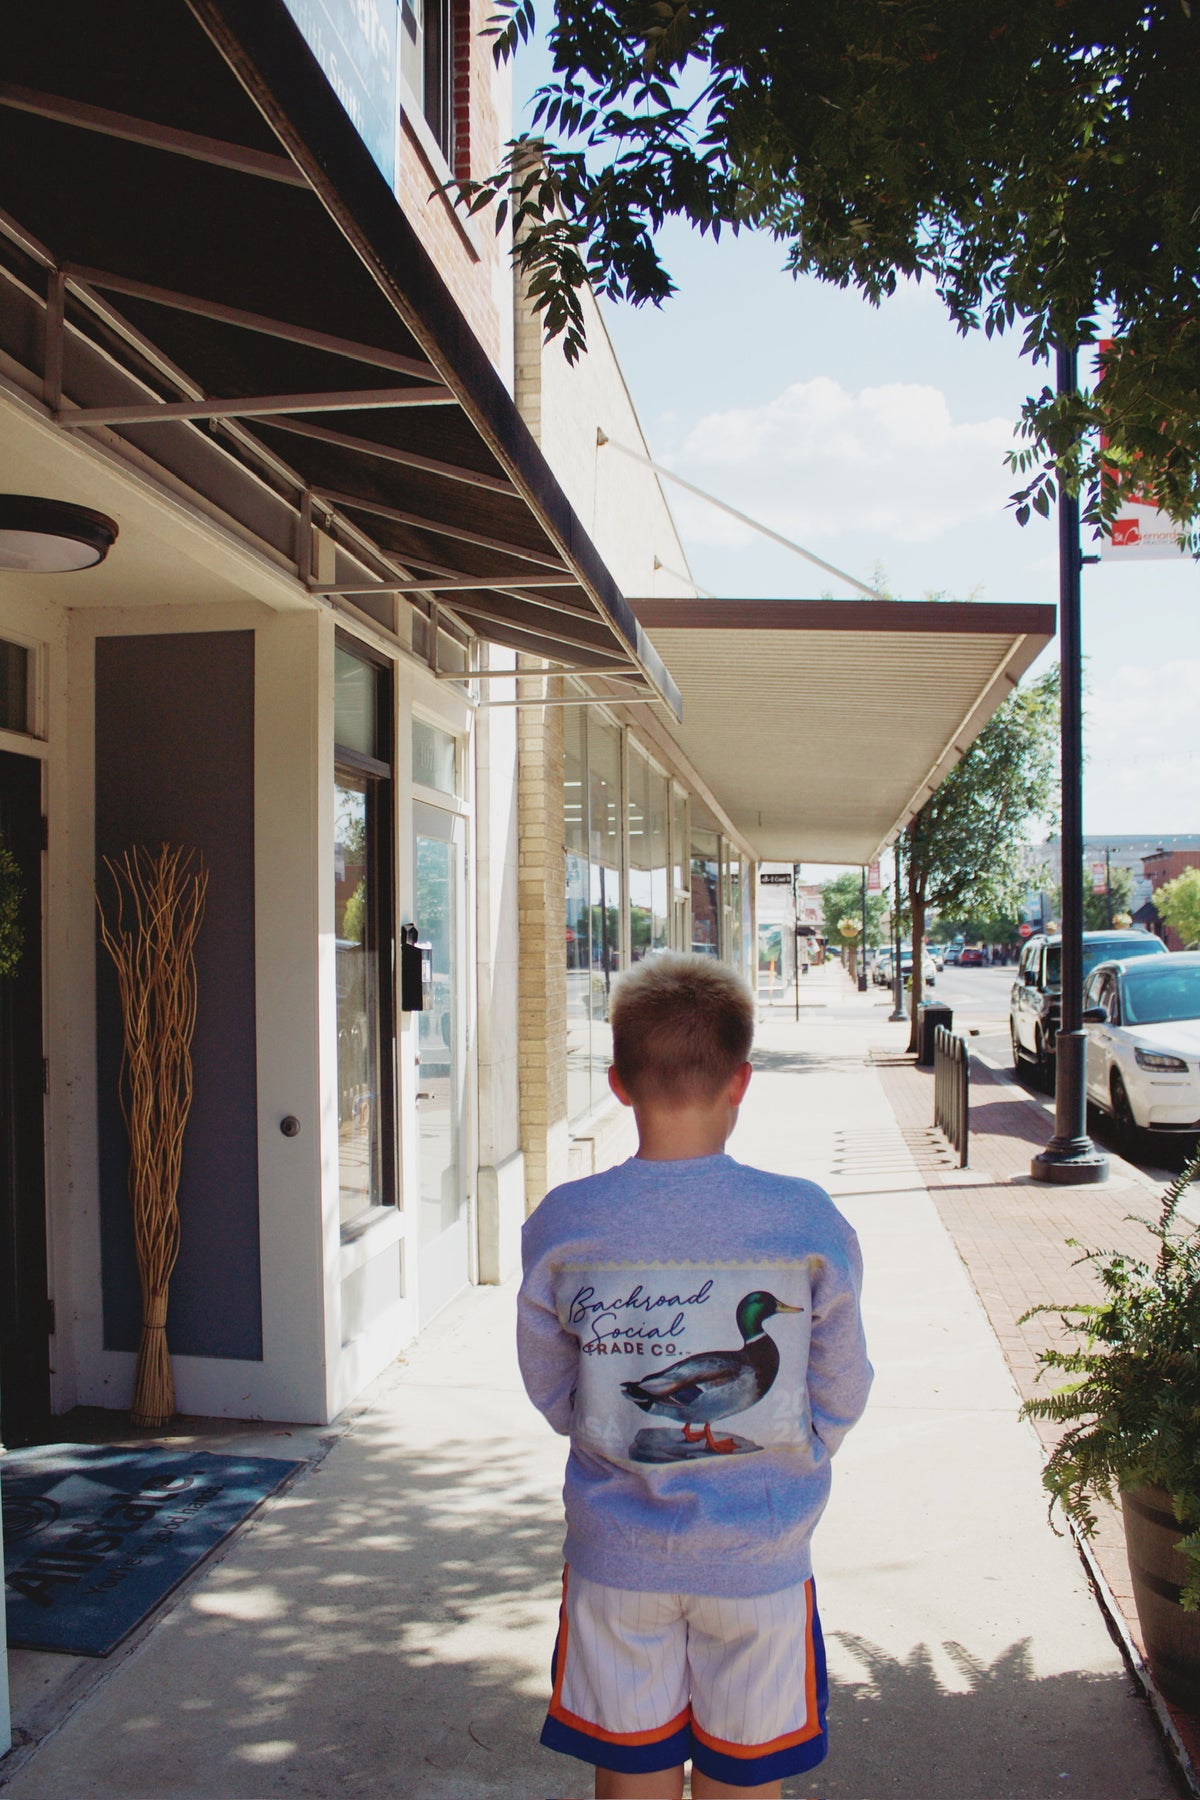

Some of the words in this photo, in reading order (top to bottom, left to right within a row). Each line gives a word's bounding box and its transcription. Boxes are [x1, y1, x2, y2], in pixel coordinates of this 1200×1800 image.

[568, 1279, 714, 1323] Backroad
[582, 1312, 686, 1353] Social
[585, 1341, 644, 1356] TRADE
